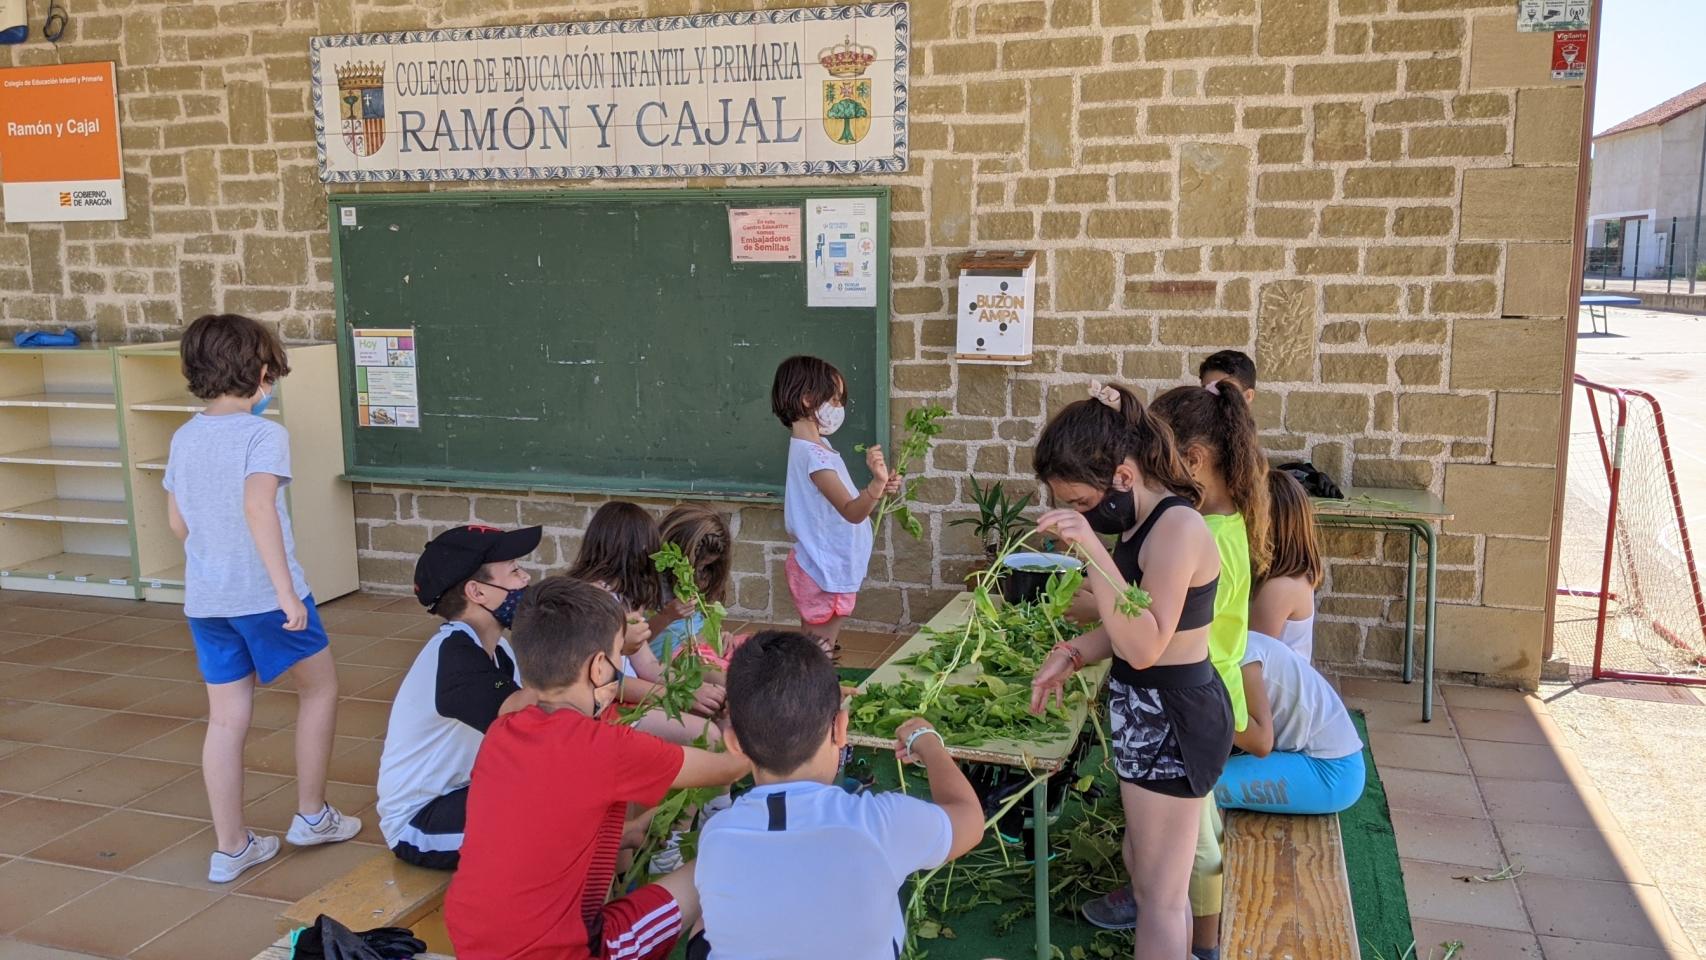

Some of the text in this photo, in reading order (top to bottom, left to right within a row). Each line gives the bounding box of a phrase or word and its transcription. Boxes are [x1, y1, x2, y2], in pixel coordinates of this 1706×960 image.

[396, 41, 802, 96] COLEGIO DE EDUCACIÓN INFANTIL Y PRIMARIA
[4, 80, 23, 88] Colegio
[32, 77, 58, 86] Educación
[59, 76, 76, 84] Infantil
[82, 75, 103, 83] Primaria
[7, 118, 100, 138] Ramón y Cajal
[398, 96, 802, 152] RAMÓN Y CAJAL
[73, 190, 107, 199] GOBIERNO
[73, 199, 82, 207] DE
[741, 235, 791, 244] Embajadores
[744, 242, 789, 251] de Semillas
[978, 309, 1020, 322] AMPA
